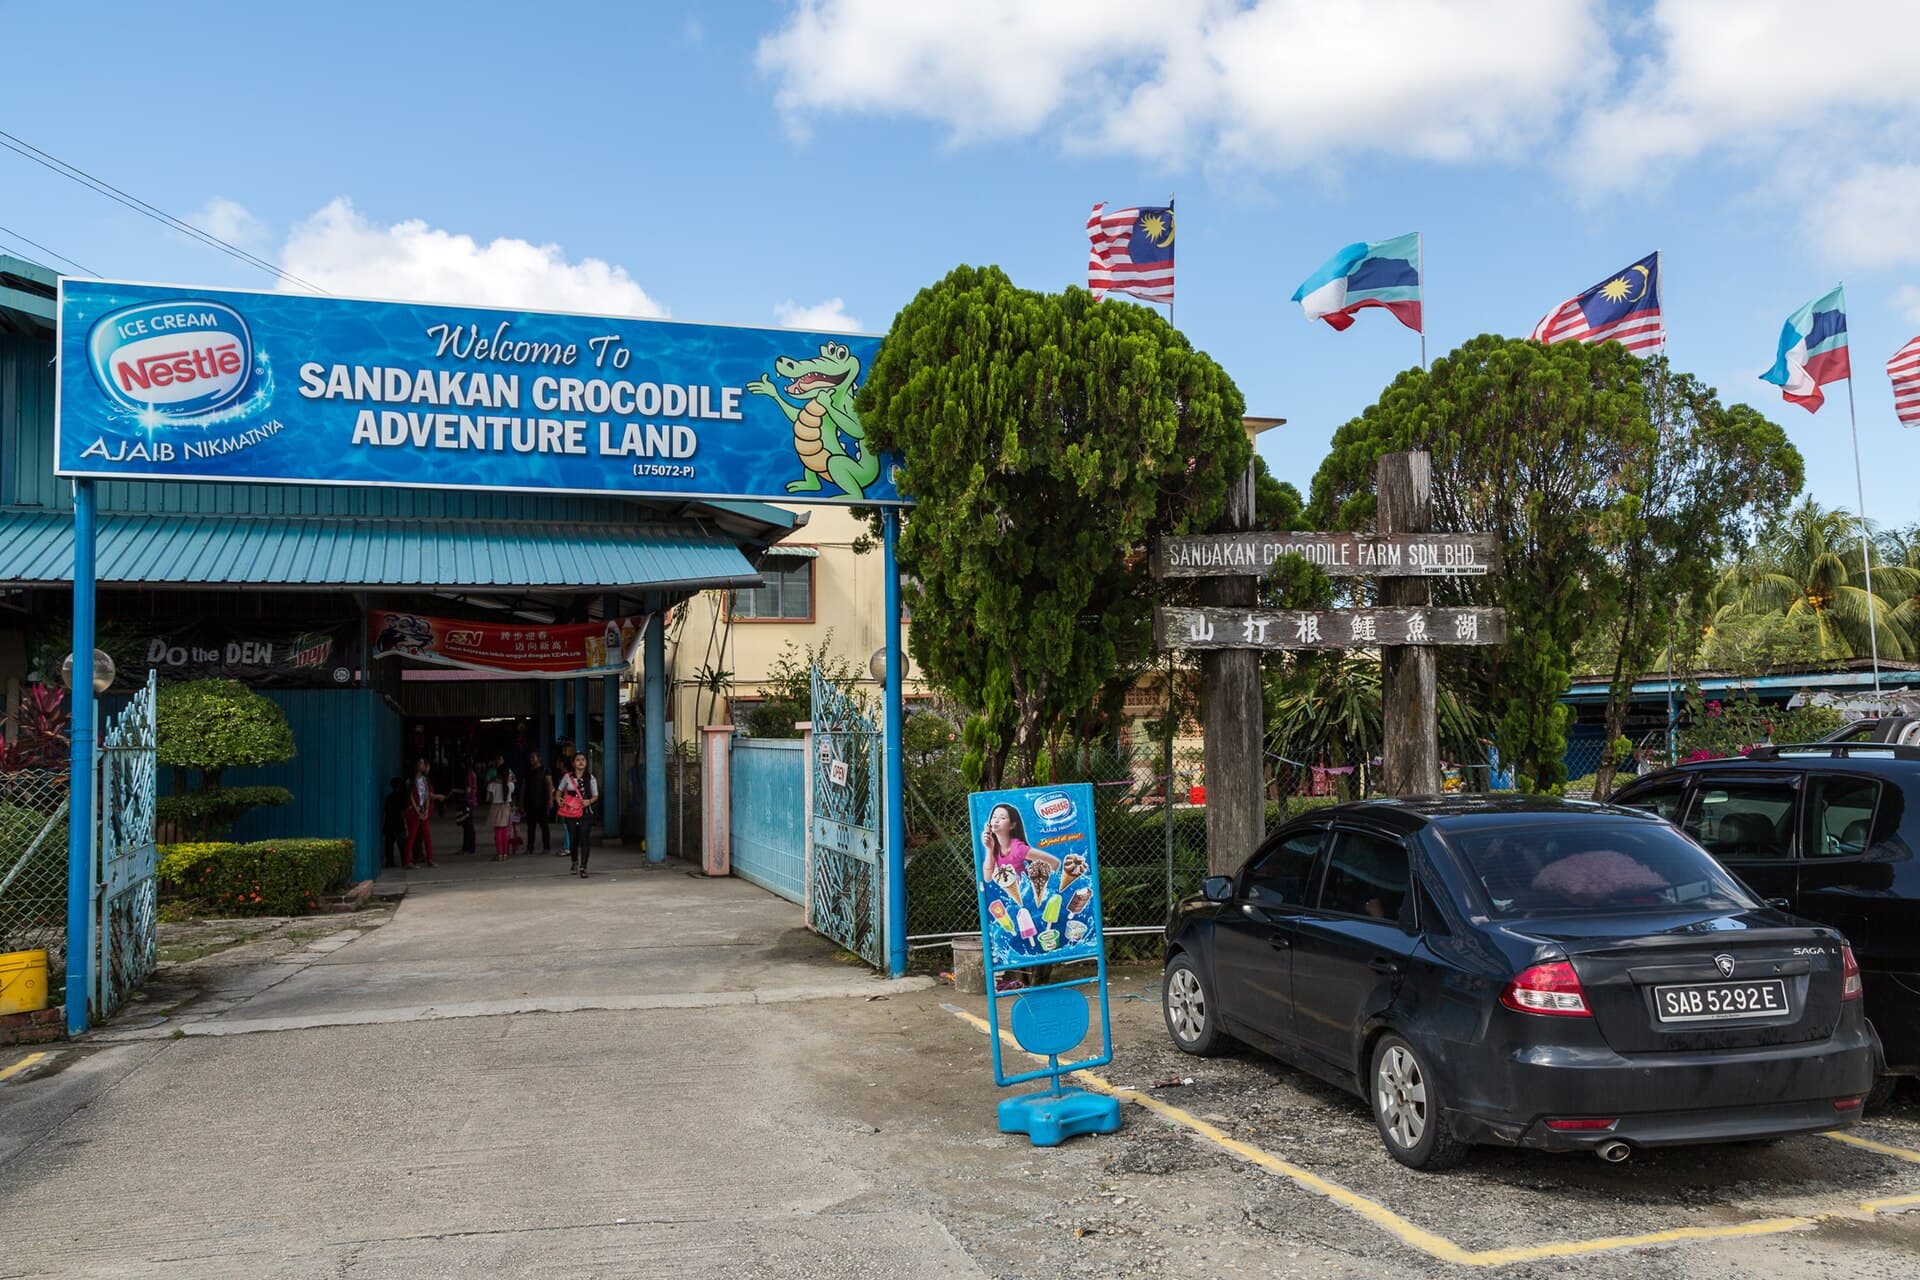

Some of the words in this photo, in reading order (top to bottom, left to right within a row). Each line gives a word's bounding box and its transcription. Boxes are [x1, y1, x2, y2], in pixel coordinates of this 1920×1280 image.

[117, 319, 149, 340] ICE
[150, 313, 218, 330] CREAM
[426, 320, 577, 366] Welcome
[588, 334, 630, 369] To
[298, 362, 519, 409] SANDAKAN
[532, 376, 743, 420] CROCODILE
[79, 436, 176, 463] AJAIB
[183, 419, 285, 460] NIKMATNYA
[351, 410, 588, 455] ADVENTURE
[599, 422, 697, 459] LAND
[633, 463, 695, 479] (175072-P)
[1169, 543, 1256, 566] SANDAKAN
[1358, 543, 1401, 566] FARM
[1190, 613, 1479, 644] 山打根鱷魚湖
[191, 647, 219, 663] the
[226, 641, 273, 665] DEW
[833, 765, 845, 780] OPEN
[1793, 947, 1825, 955] SAGA
[1666, 991, 1703, 1014] SAB
[1707, 988, 1762, 1012] 5292
[1764, 986, 1777, 1009] E
